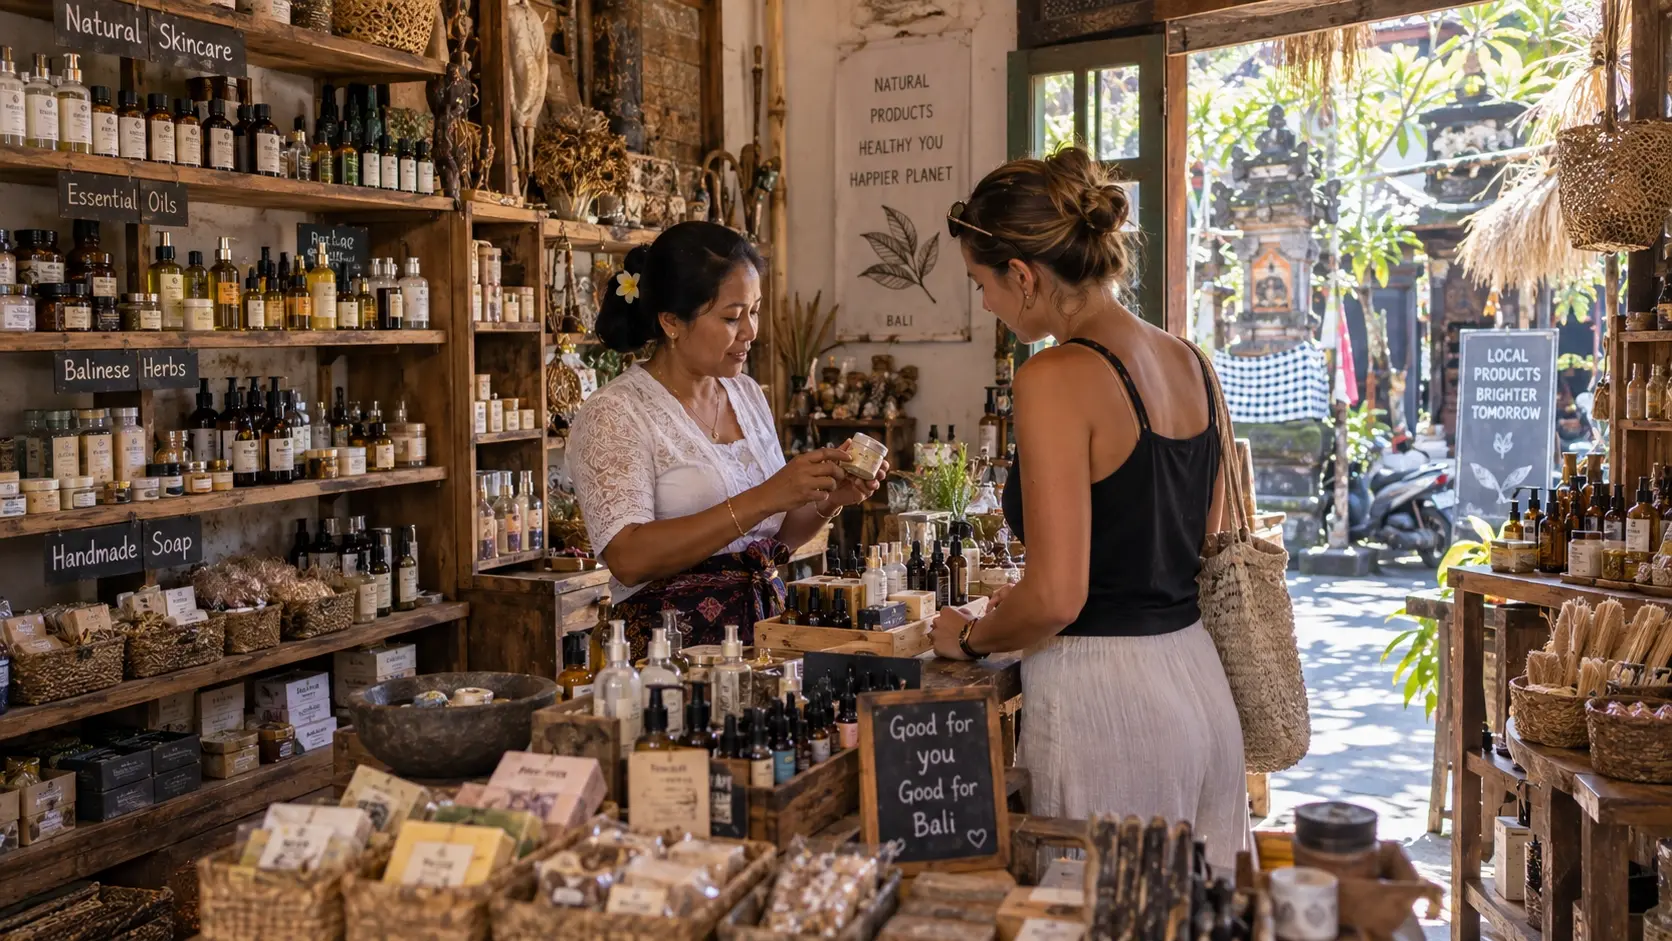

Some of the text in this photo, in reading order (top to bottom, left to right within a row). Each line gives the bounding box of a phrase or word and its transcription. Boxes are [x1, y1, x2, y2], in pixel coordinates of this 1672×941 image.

[65, 3, 233, 61] Natural Skincare
[875, 73, 929, 92] NATURAL
[871, 103, 933, 123] PRODUCTS
[860, 134, 943, 156] HEALTHY YOU
[850, 165, 953, 187] HAPPIER PLANET
[67, 182, 177, 214] Essential Oils
[886, 314, 913, 327] BALI
[1487, 348, 1529, 363] LOCAL
[64, 355, 186, 381] Balinese Herbs
[1474, 367, 1541, 381] PRODUCTS
[1476, 387, 1537, 402] BRIGHTER
[1471, 405, 1541, 420] TOMORROW
[52, 530, 192, 570] Handmade Soap
[889, 710, 974, 742] Good for
[916, 748, 956, 776] you
[898, 774, 978, 805] Good for
[912, 808, 956, 838] Bali
